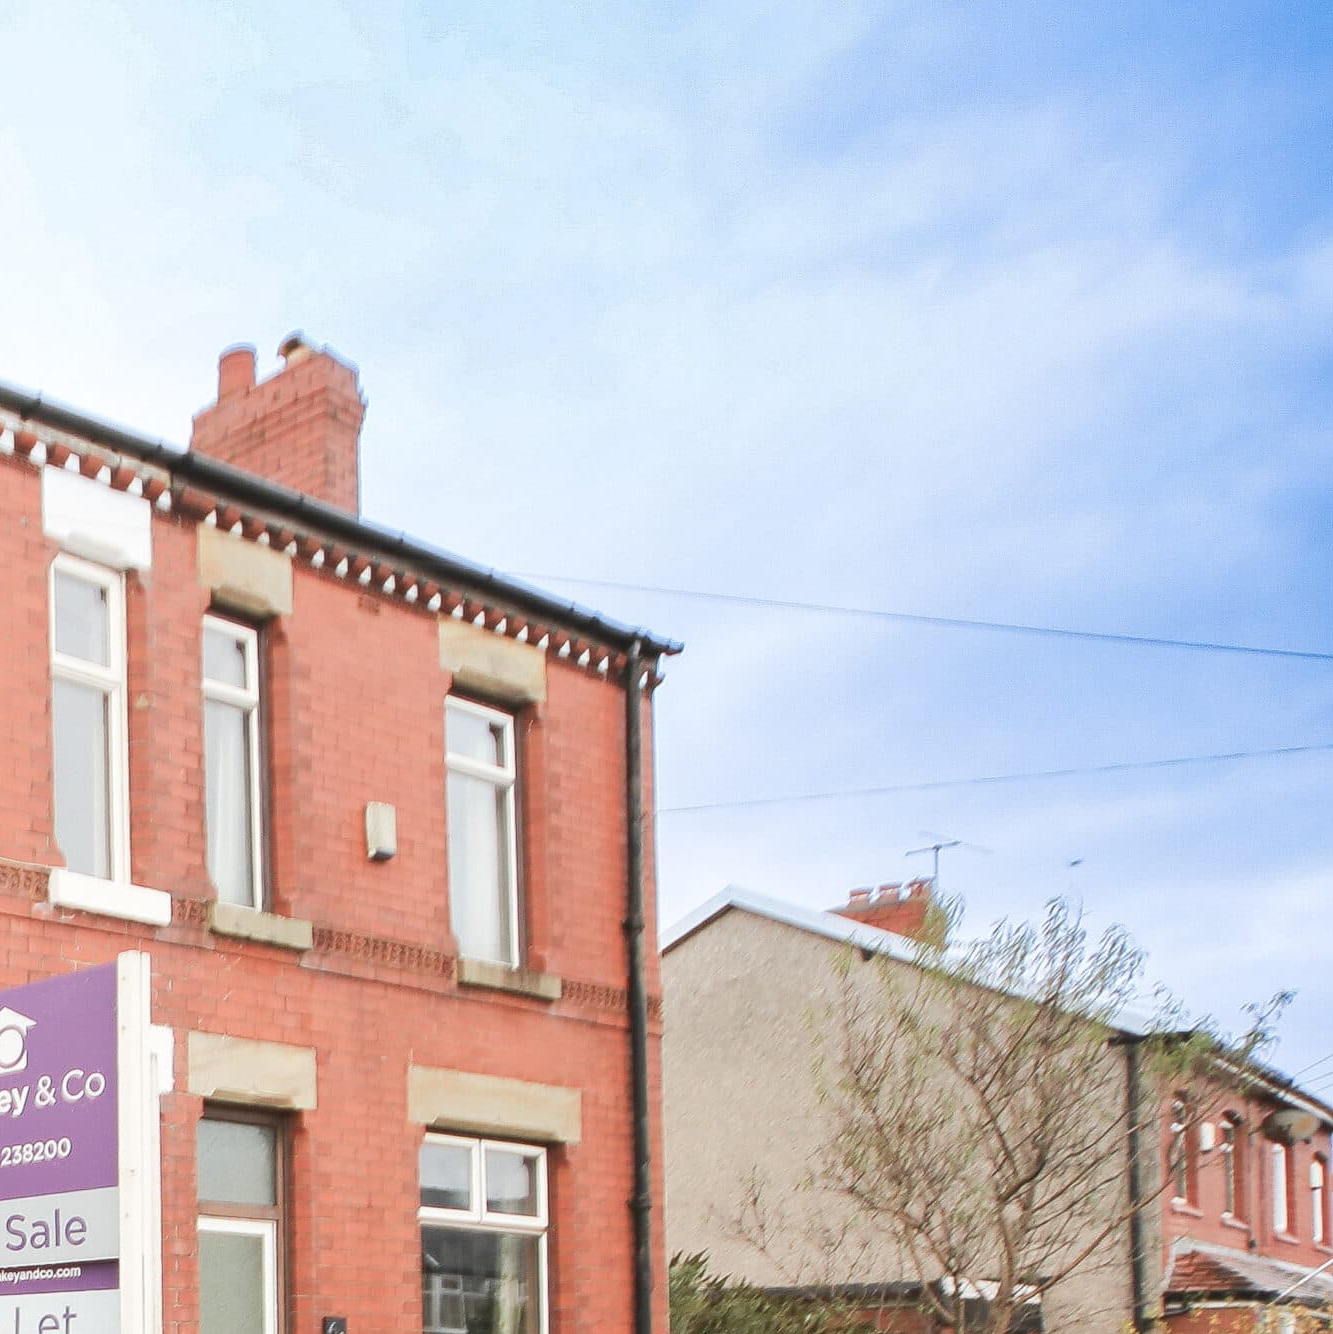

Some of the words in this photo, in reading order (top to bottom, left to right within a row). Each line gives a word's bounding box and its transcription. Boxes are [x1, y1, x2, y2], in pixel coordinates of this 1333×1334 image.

[35, 1075, 56, 1107] &
[61, 1069, 106, 1101] Co
[1, 1137, 72, 1167] 238200
[6, 1208, 87, 1252] Sale
